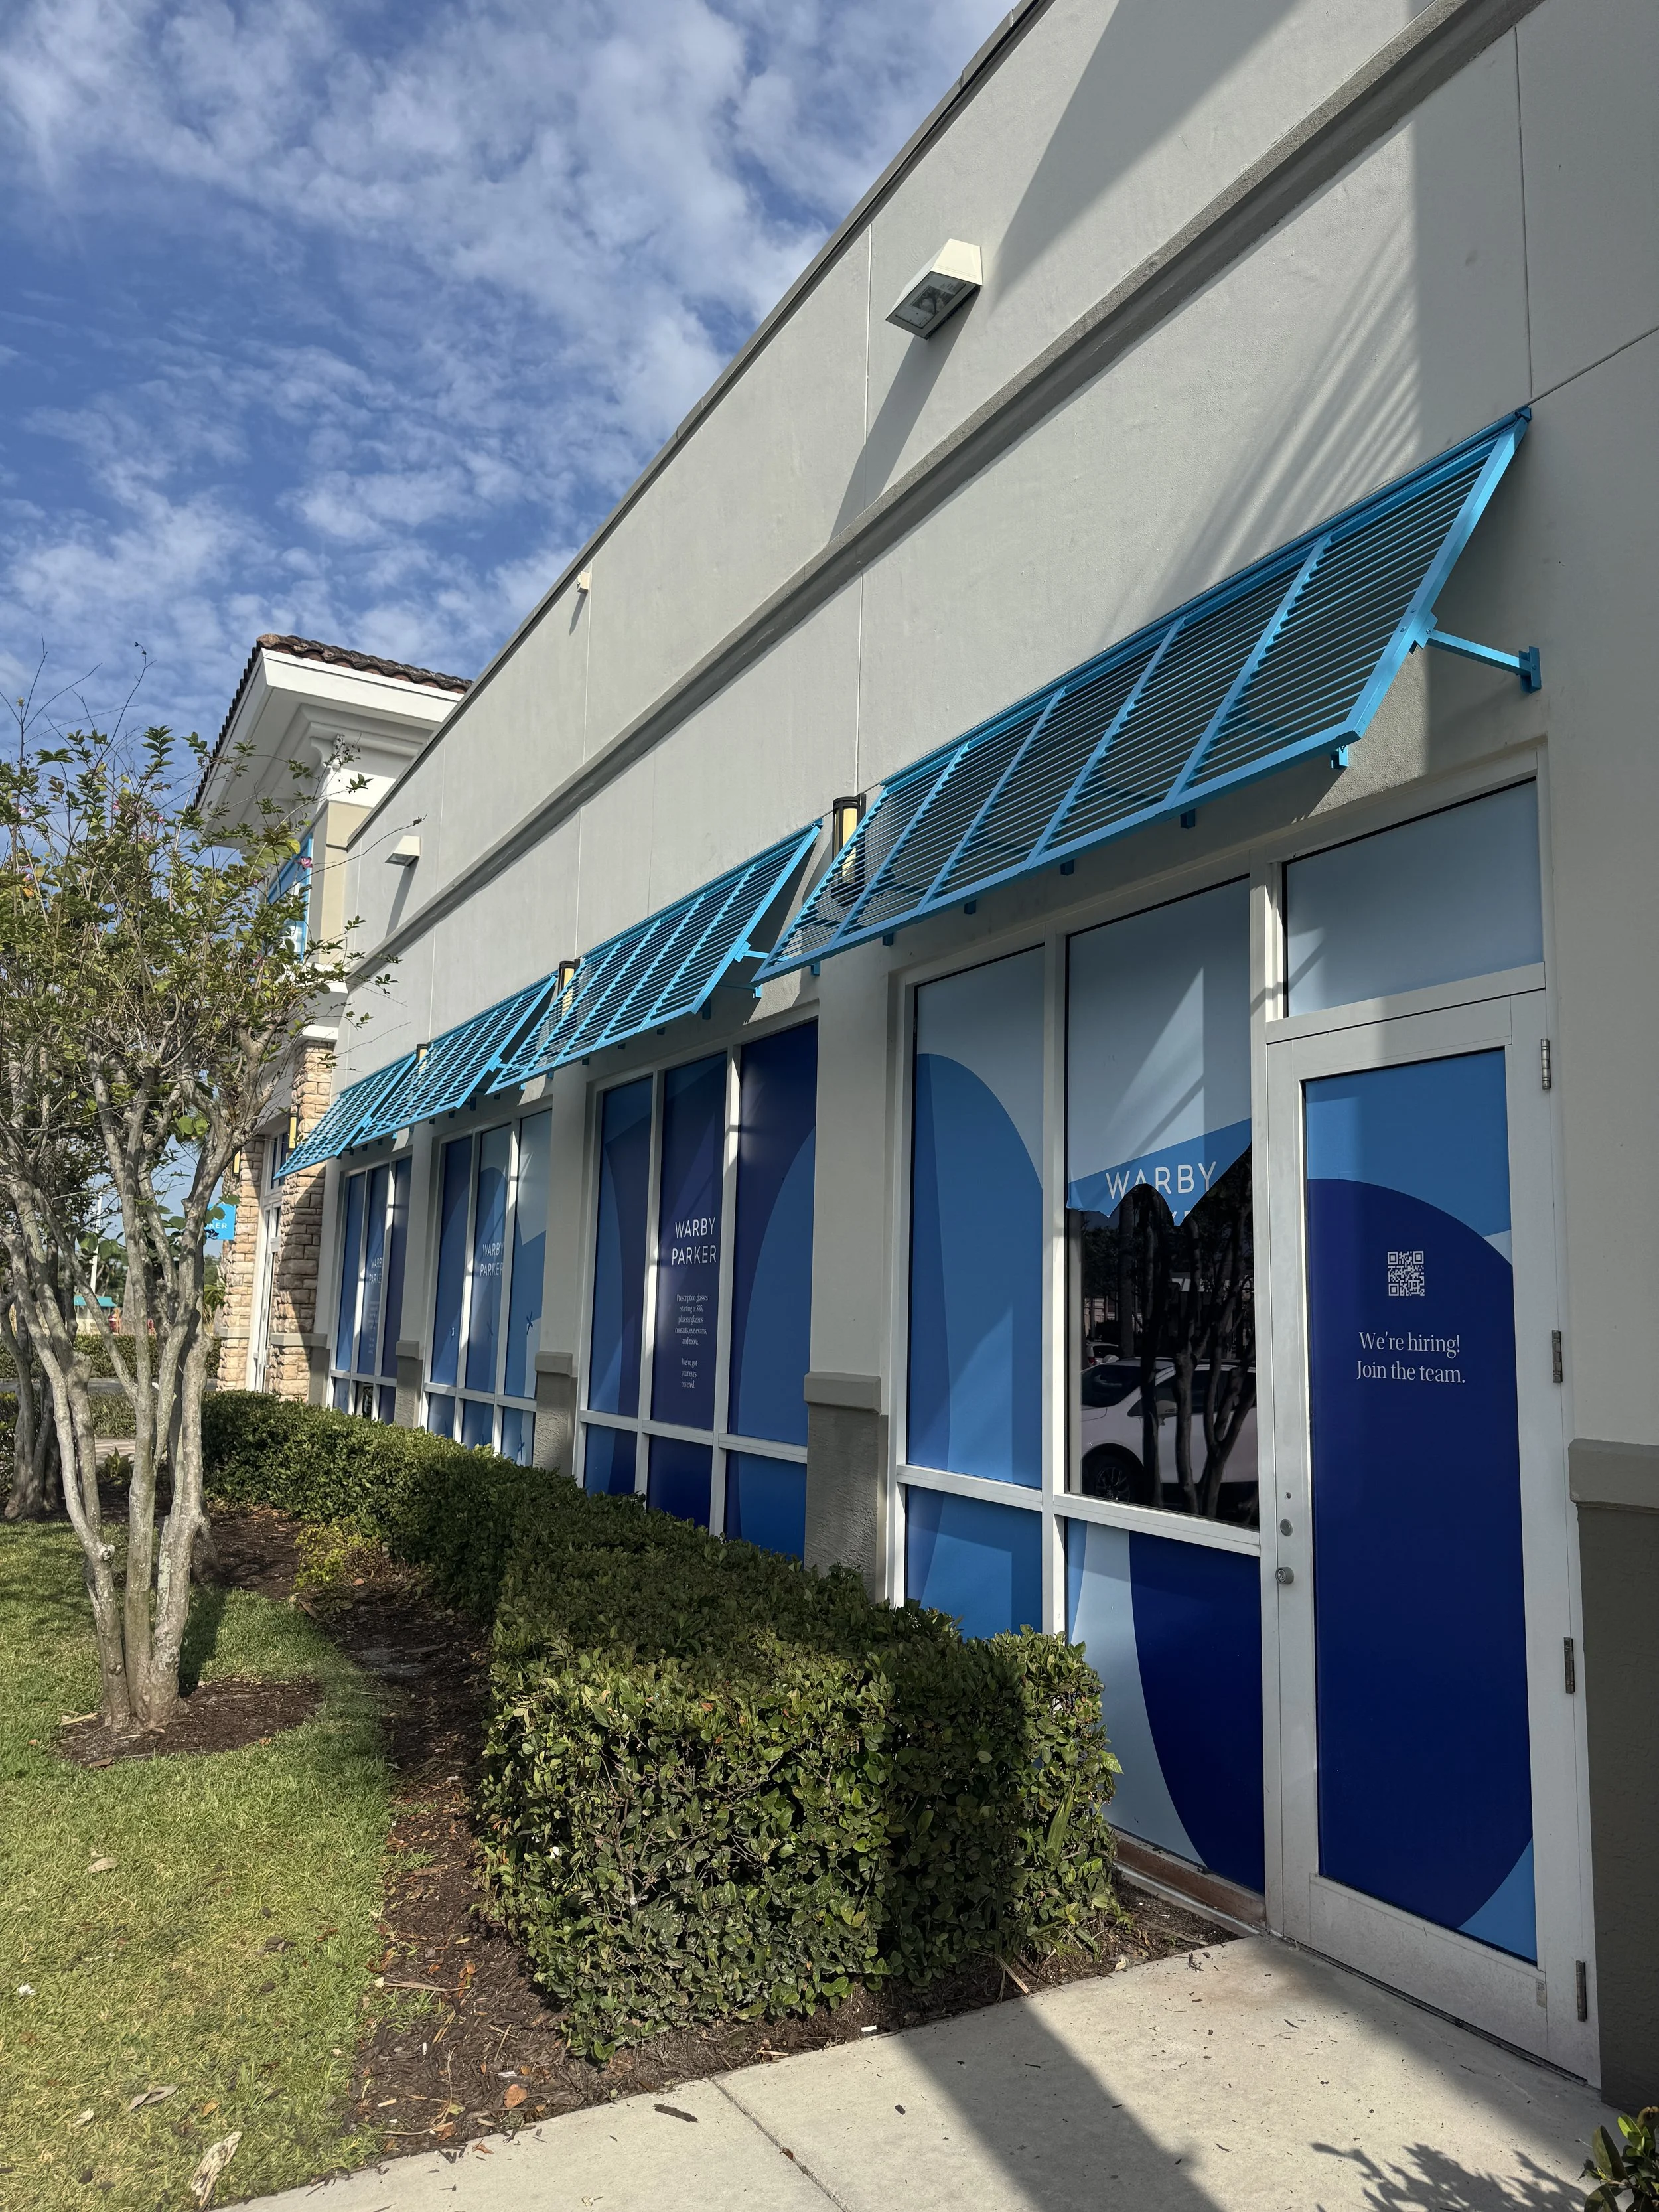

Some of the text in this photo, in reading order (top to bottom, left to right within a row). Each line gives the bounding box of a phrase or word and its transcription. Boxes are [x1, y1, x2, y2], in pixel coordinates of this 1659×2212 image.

[675, 1217, 716, 1239] WARBY
[482, 1242, 504, 1257] WARBY
[672, 1244, 717, 1266] PARKER
[370, 1257, 382, 1268] WARB
[369, 1274, 382, 1285] PARKE
[676, 1293, 709, 1303] Prescription glasses
[680, 1305, 693, 1314] starting
[1358, 1331, 1461, 1359] We're hiring!
[1356, 1360, 1465, 1384] Join the team.
